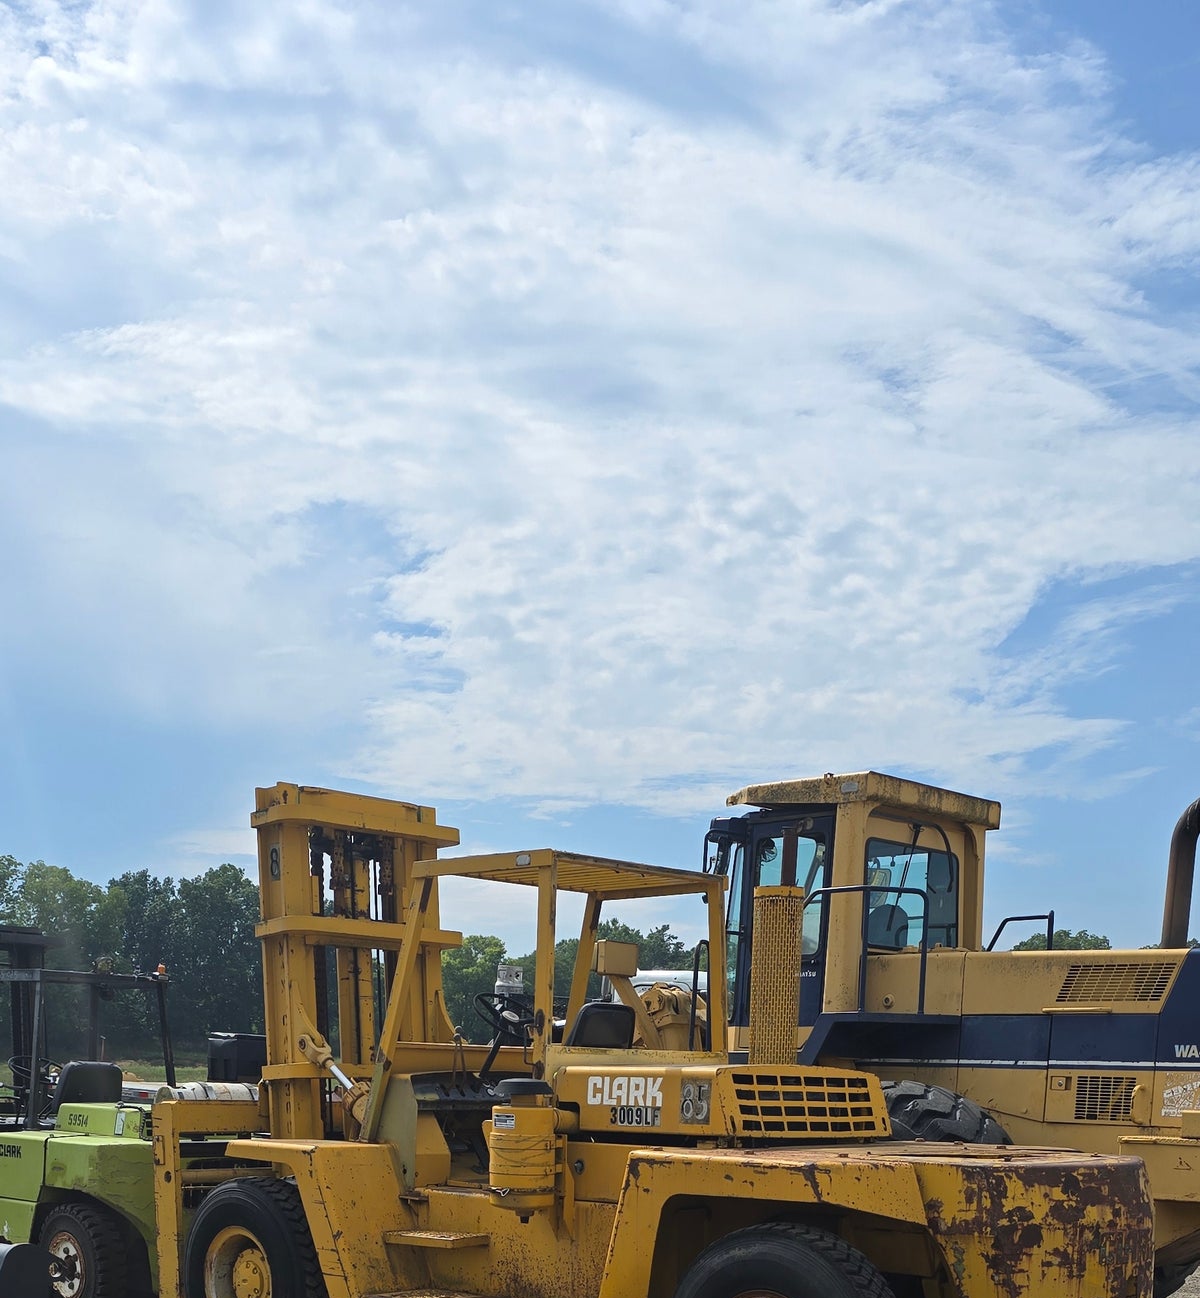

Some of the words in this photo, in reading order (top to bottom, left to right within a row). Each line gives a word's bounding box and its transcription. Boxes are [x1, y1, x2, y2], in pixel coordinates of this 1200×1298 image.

[1174, 1044, 1200, 1058] WA
[587, 1076, 663, 1107] CLARK
[68, 1113, 89, 1128] 59514
[610, 1107, 661, 1126] 3009LF
[0, 1144, 22, 1159] CLARK
